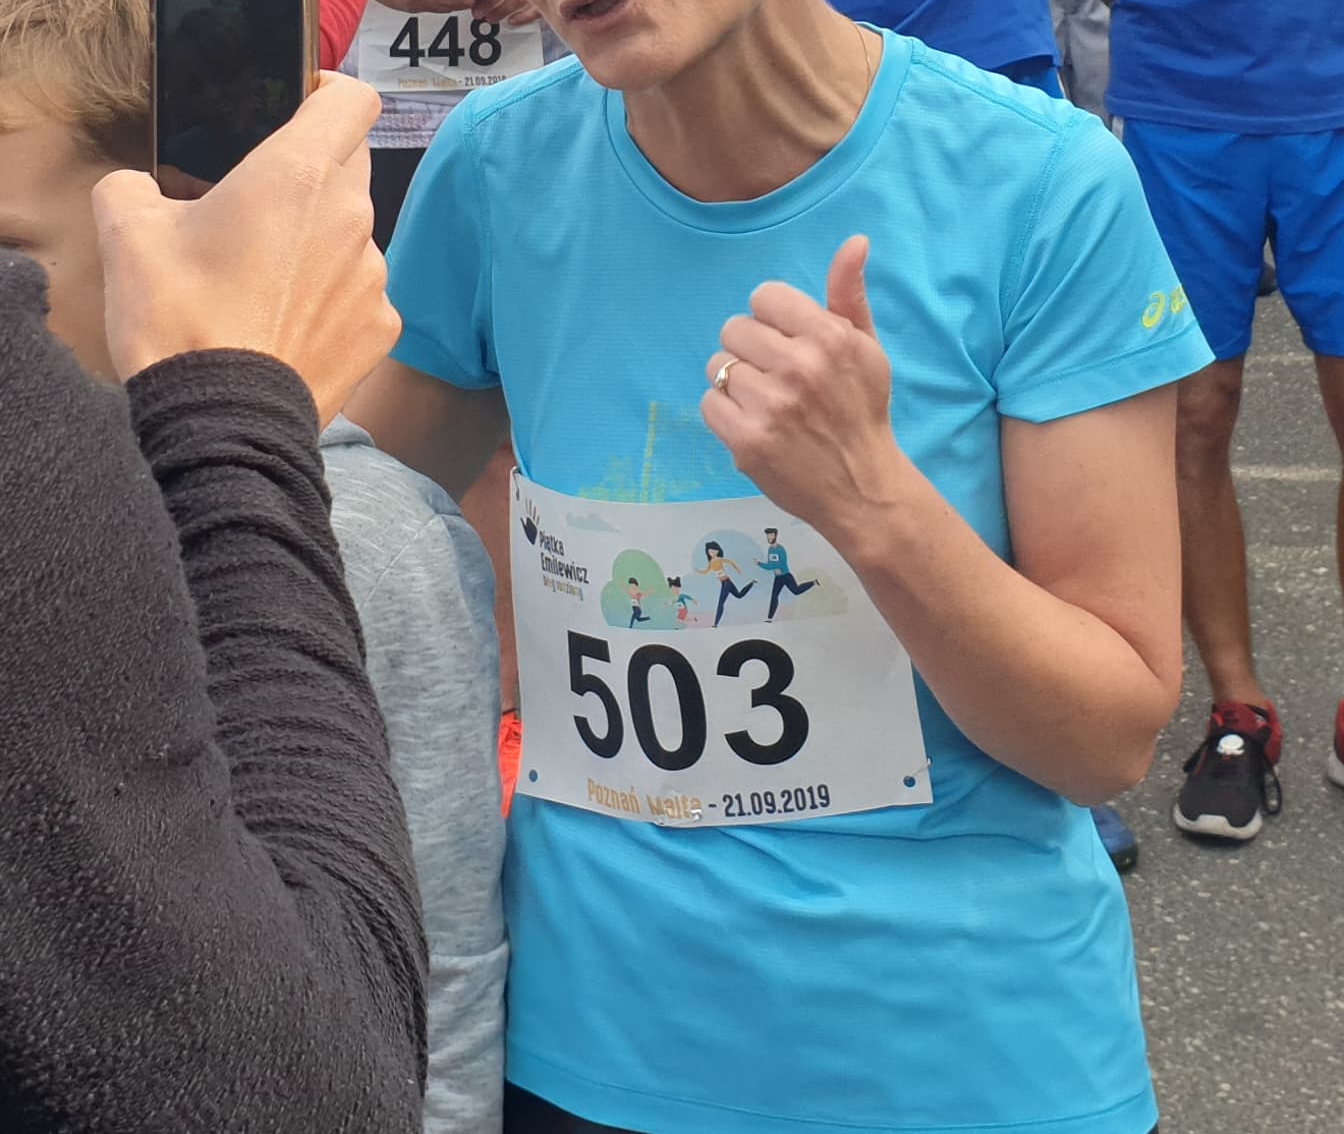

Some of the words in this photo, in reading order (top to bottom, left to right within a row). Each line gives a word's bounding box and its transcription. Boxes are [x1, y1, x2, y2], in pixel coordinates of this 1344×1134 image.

[389, 16, 502, 67] 448
[540, 530, 564, 556] Piątka
[541, 552, 589, 584] Emilewicz
[568, 630, 809, 771] 503
[587, 778, 640, 814] Poznań
[723, 784, 830, 817] 21.09.2019
